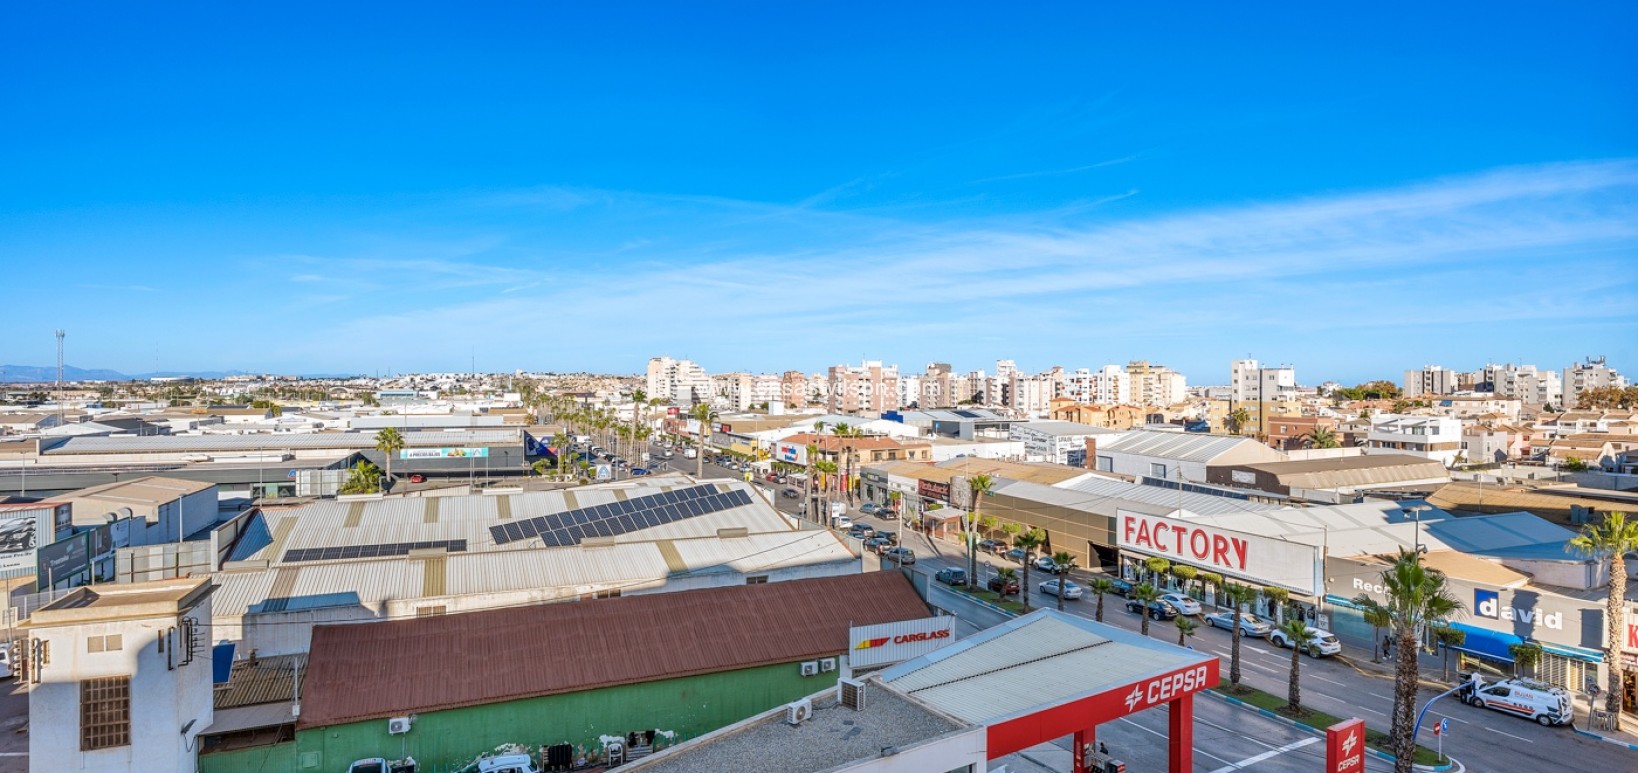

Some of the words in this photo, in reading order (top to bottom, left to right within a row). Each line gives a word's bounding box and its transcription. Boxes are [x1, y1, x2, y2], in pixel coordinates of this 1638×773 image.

[1124, 516, 1247, 570] FACTORY
[1479, 598, 1562, 630] david
[893, 628, 950, 645] CARGLASS
[1147, 665, 1207, 704] CEPSA
[1337, 754, 1360, 772] CEPSA
